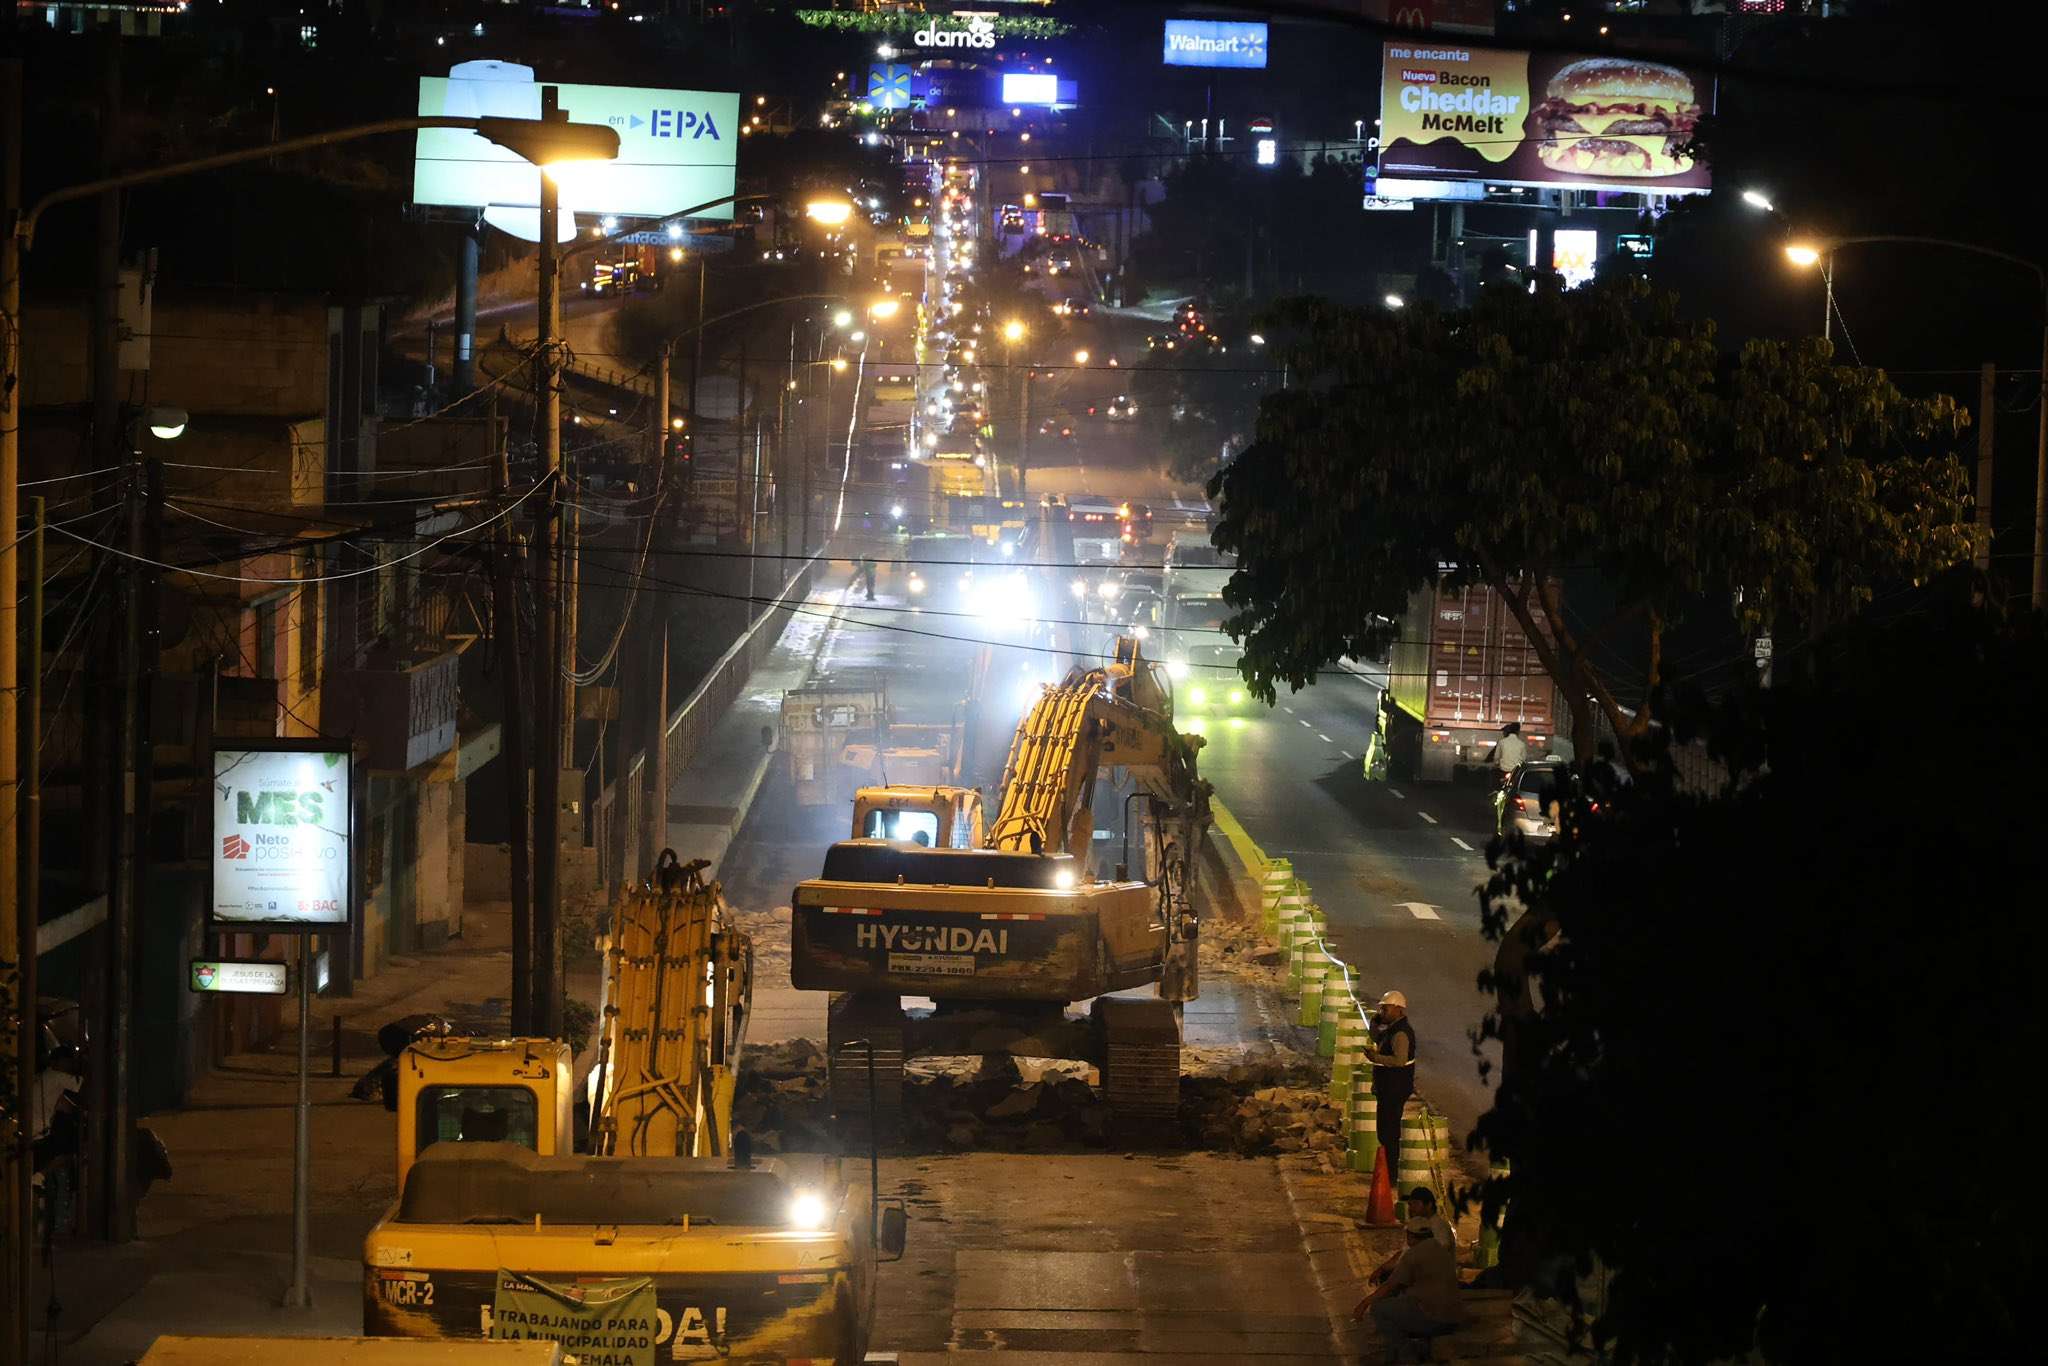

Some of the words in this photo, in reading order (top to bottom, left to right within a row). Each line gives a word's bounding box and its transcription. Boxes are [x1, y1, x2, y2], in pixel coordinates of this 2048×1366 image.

[914, 20, 995, 48] alamos
[1169, 34, 1239, 52] Walmart
[1390, 48, 1412, 58] me
[1413, 49, 1470, 62] encanta
[1402, 70, 1436, 81] Nueva
[1439, 72, 1490, 87] Bacon
[1400, 86, 1520, 116] Cheddar
[608, 116, 625, 125] en
[651, 109, 720, 140] EPA
[1421, 113, 1504, 134] McMelt
[236, 790, 323, 826] MES
[255, 834, 289, 845] Neto
[312, 900, 338, 911] BAC
[856, 922, 1008, 954] HYUNDAI
[385, 1280, 434, 1305] MCR-2
[499, 1311, 602, 1331] TRABAJANDO
[607, 1318, 650, 1331] PARA
[502, 1328, 521, 1340] LA
[526, 1330, 650, 1349] MUNICIPALIDAD
